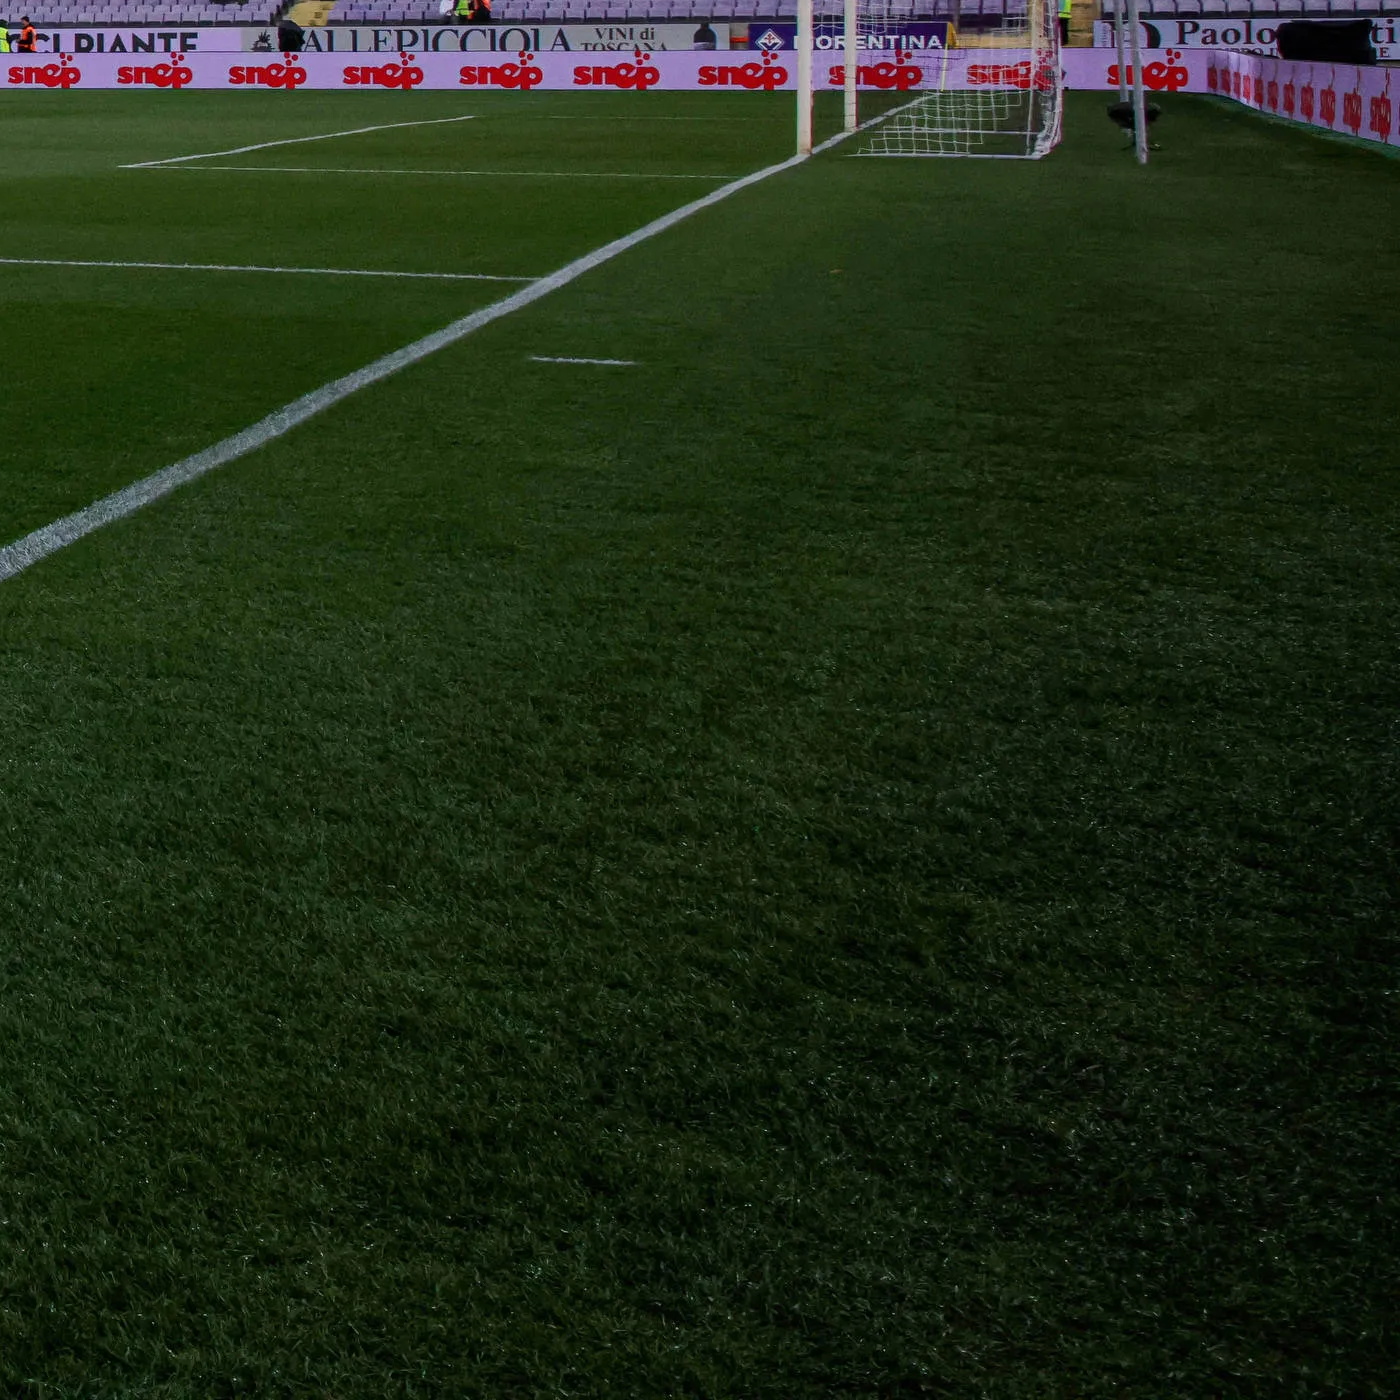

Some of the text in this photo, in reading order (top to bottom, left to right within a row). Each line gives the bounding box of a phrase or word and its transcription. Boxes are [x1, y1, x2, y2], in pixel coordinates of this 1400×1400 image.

[74, 33, 198, 52] PIANTE
[301, 28, 572, 52] ALLEPICCIOLA
[596, 28, 654, 40] VINI di
[794, 34, 943, 50] ORENTINA
[1176, 20, 1276, 44] Paolo
[8, 64, 81, 88] snep
[118, 64, 193, 88] snep
[228, 64, 307, 89] snep
[344, 63, 424, 90] snep
[460, 63, 543, 90] snep
[574, 63, 660, 90] snep
[698, 63, 788, 90] snep
[1107, 62, 1188, 91] sep
